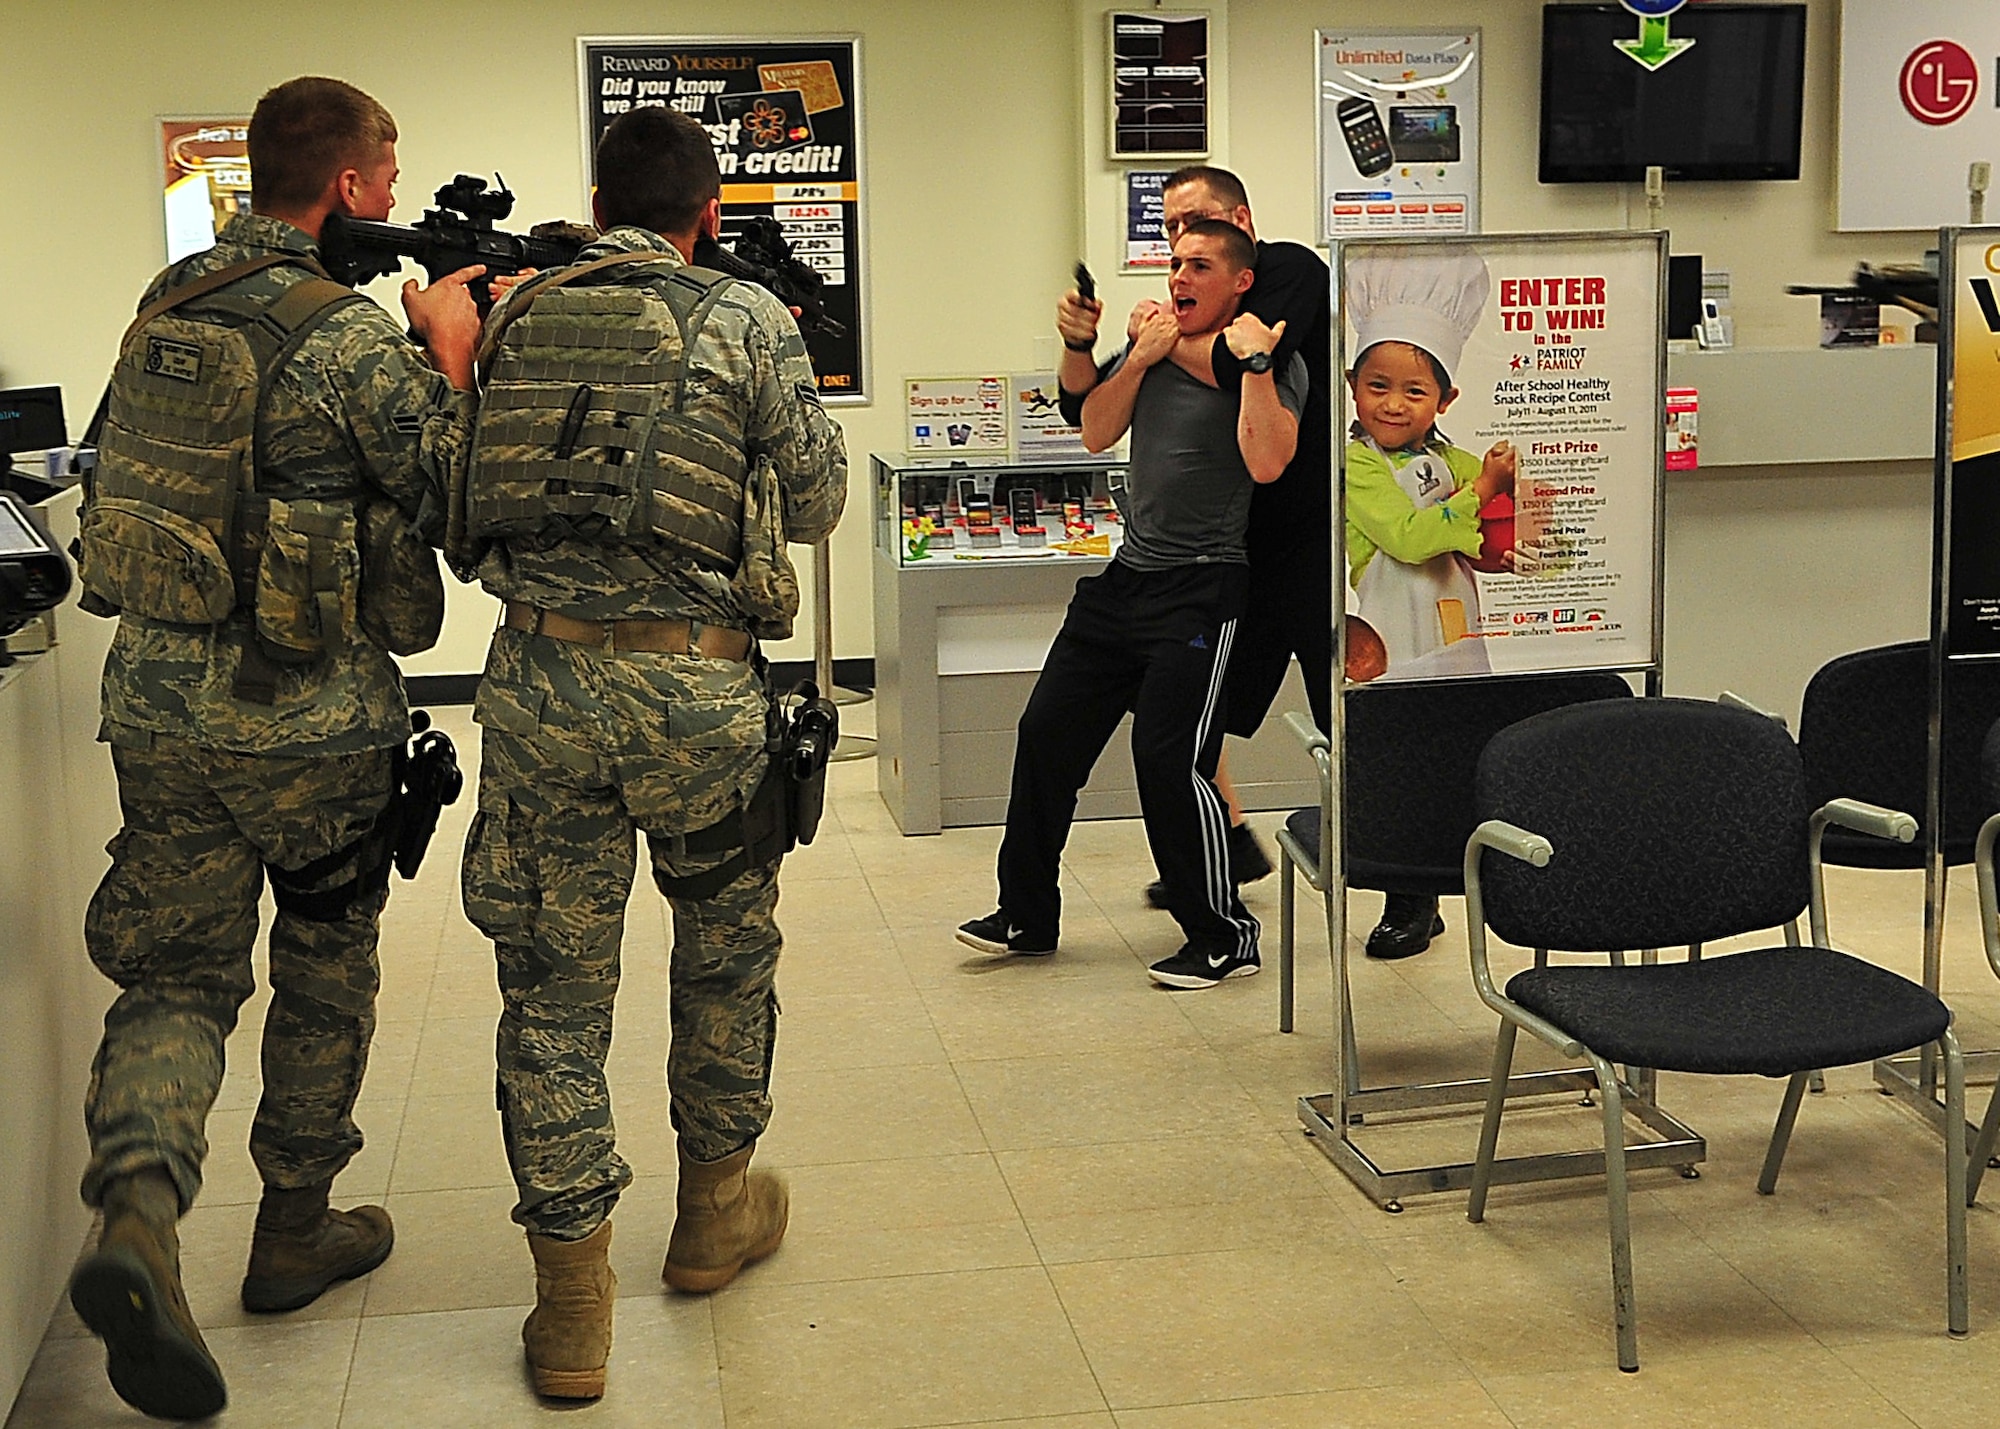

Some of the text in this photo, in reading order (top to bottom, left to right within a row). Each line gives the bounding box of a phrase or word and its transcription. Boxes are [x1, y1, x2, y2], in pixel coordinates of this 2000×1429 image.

[1336, 50, 1459, 64] Unlimited Data Plan
[602, 55, 671, 72] REWARD
[601, 77, 726, 98] Did you know
[602, 100, 630, 114] we
[670, 95, 705, 112] still
[744, 146, 842, 174] credit!
[1500, 277, 1606, 307] ENTER
[1501, 309, 1605, 332] TO WIN!
[1552, 333, 1572, 344] the
[1537, 347, 1587, 359] PATRIOT
[1537, 359, 1582, 371] FAMILY
[1495, 378, 1610, 392] After School Healthy
[910, 395, 966, 408] Sign up for
[1494, 391, 1611, 406] Snack Recipe Contest
[1537, 407, 1566, 417] August
[1580, 406, 1597, 414] 2011
[1532, 440, 1598, 455] First Prize
[1545, 457, 1579, 466] Exchange
[1581, 456, 1609, 466] giftcard
[1533, 485, 1595, 497] Second Prize
[1542, 499, 1576, 508] Exchange
[1542, 526, 1586, 535] Third Prize
[1539, 549, 1588, 558] Fourth Prize
[1542, 561, 1576, 571] Exchange
[1518, 585, 1536, 593] Family
